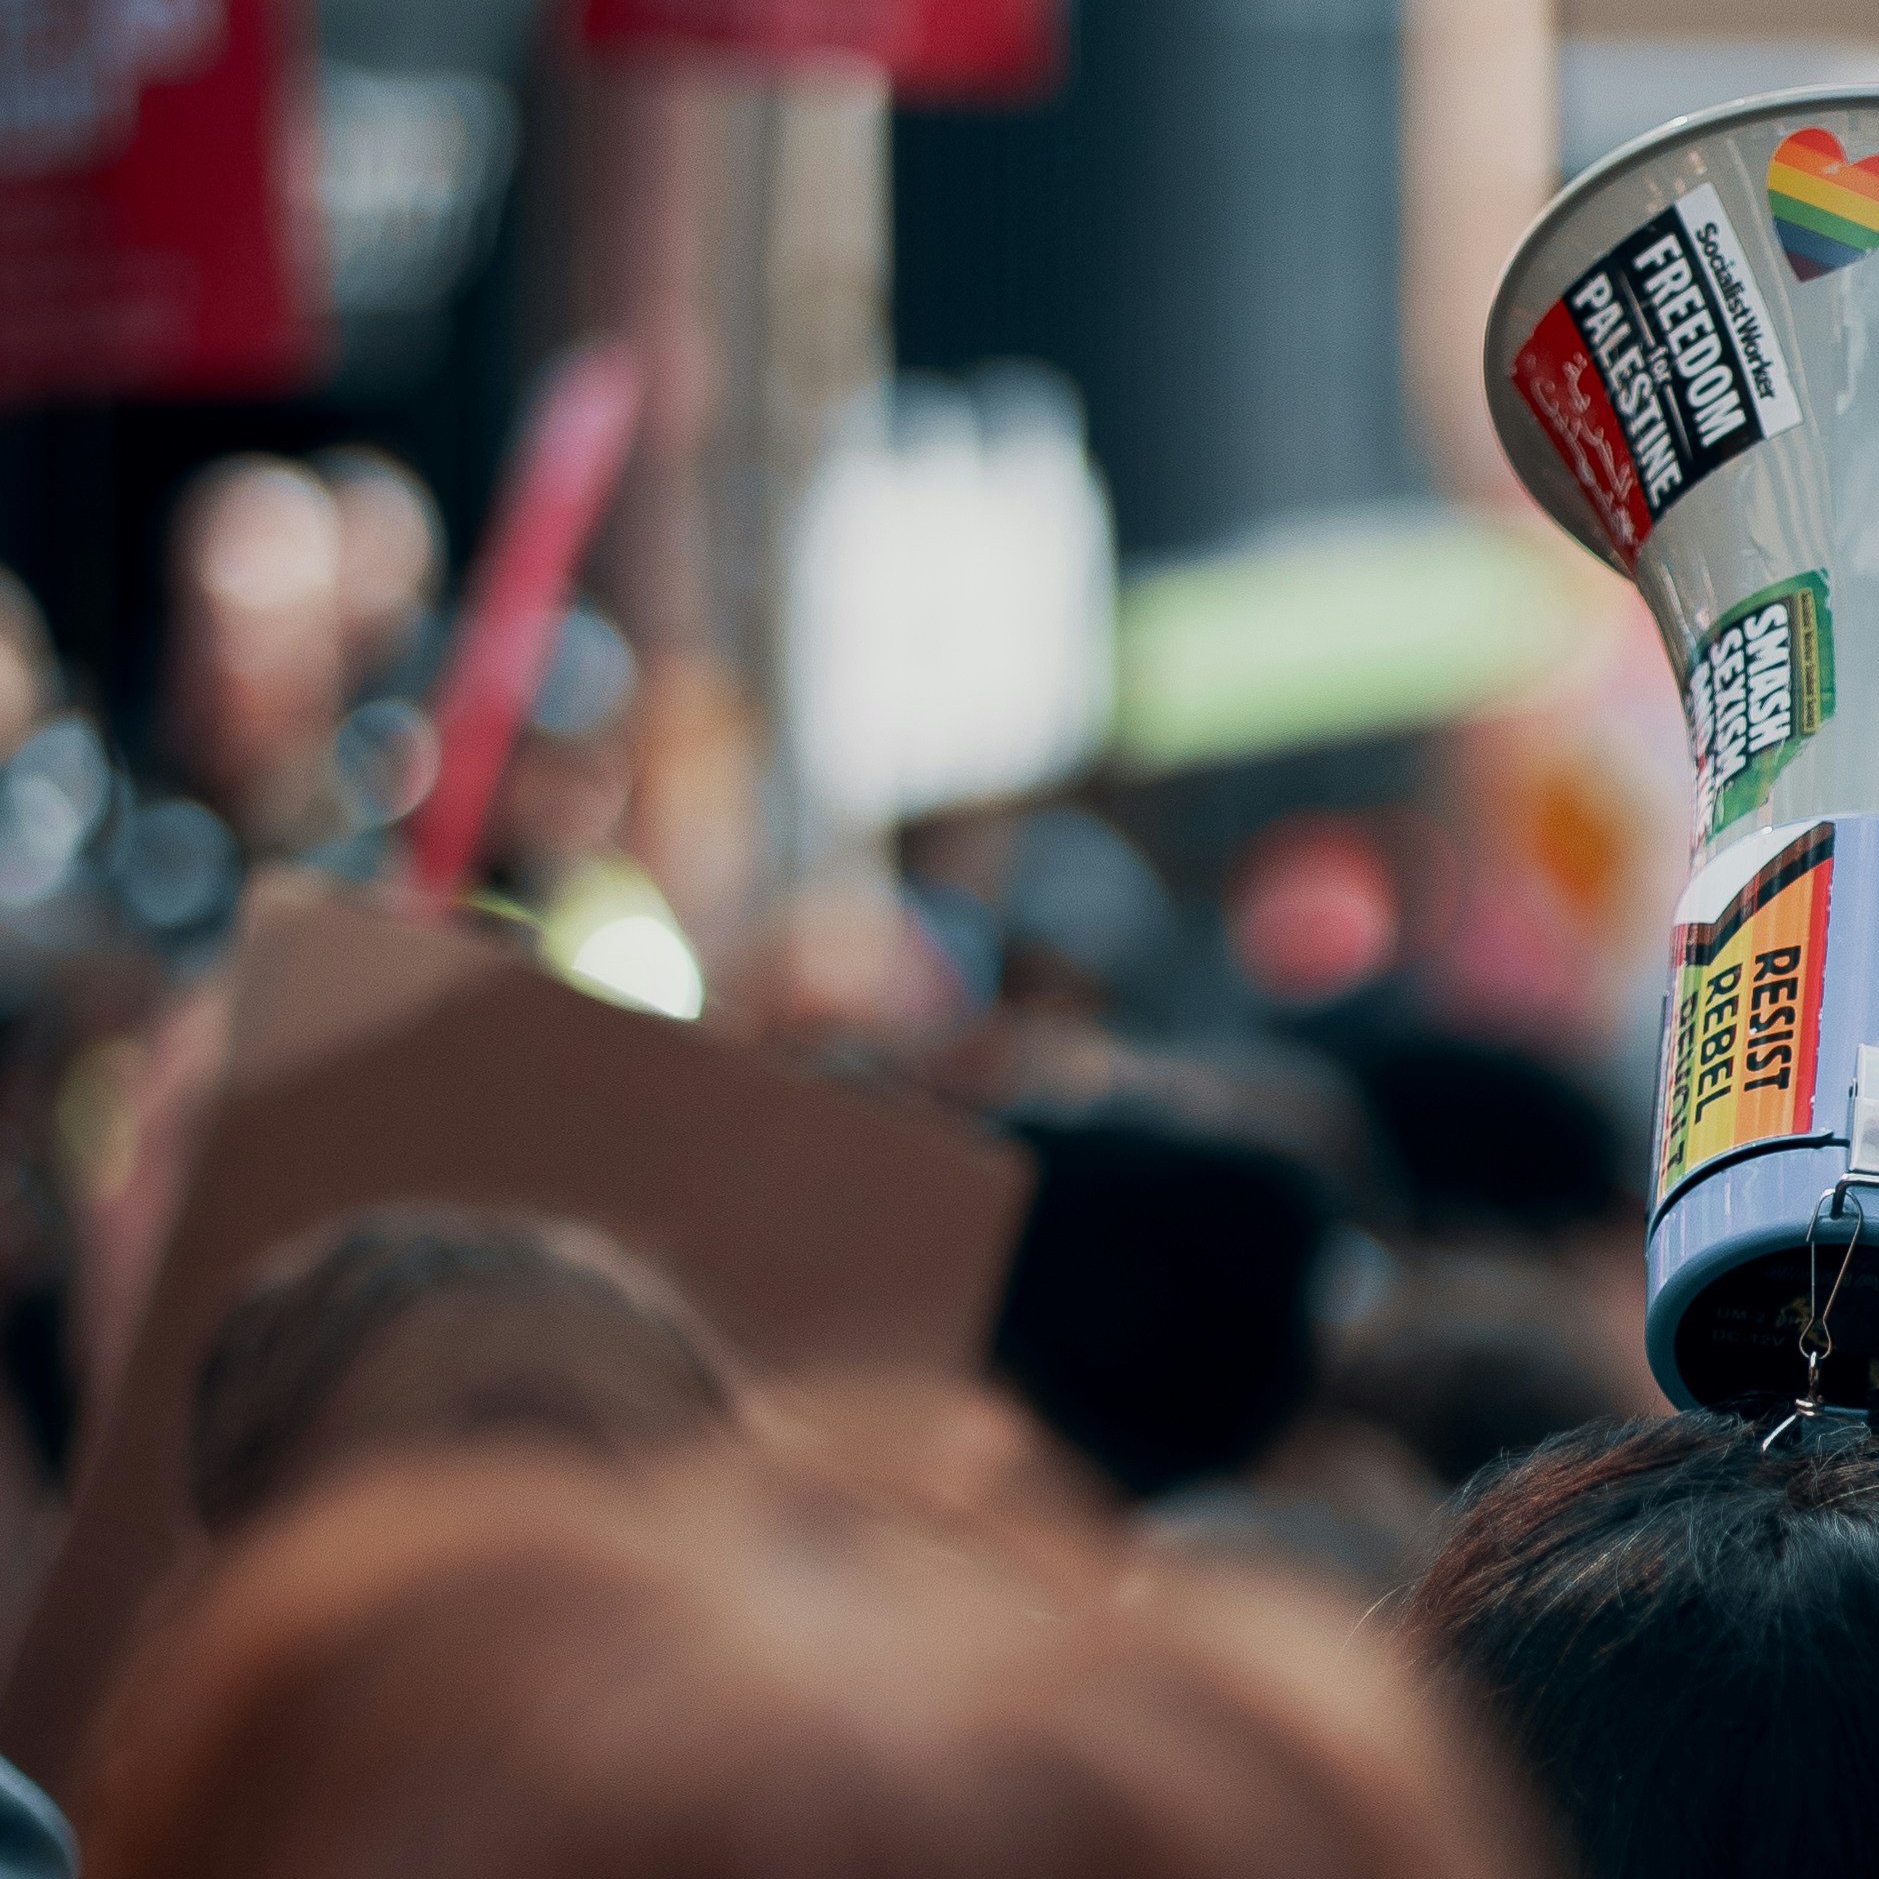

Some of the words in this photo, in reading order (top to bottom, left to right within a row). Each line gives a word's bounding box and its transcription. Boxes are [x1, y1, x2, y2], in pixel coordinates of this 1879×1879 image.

[1572, 272, 1682, 507] PALESTINE
[1633, 232, 1748, 448] FREEDOM
[1649, 345, 1672, 387] for
[1710, 627, 1747, 789] SEXISM
[1744, 603, 1791, 753] SMASH
[1667, 990, 1698, 1171] REVOLT
[1694, 962, 1743, 1125] REBEL
[1744, 945, 1801, 1092] RESIST
